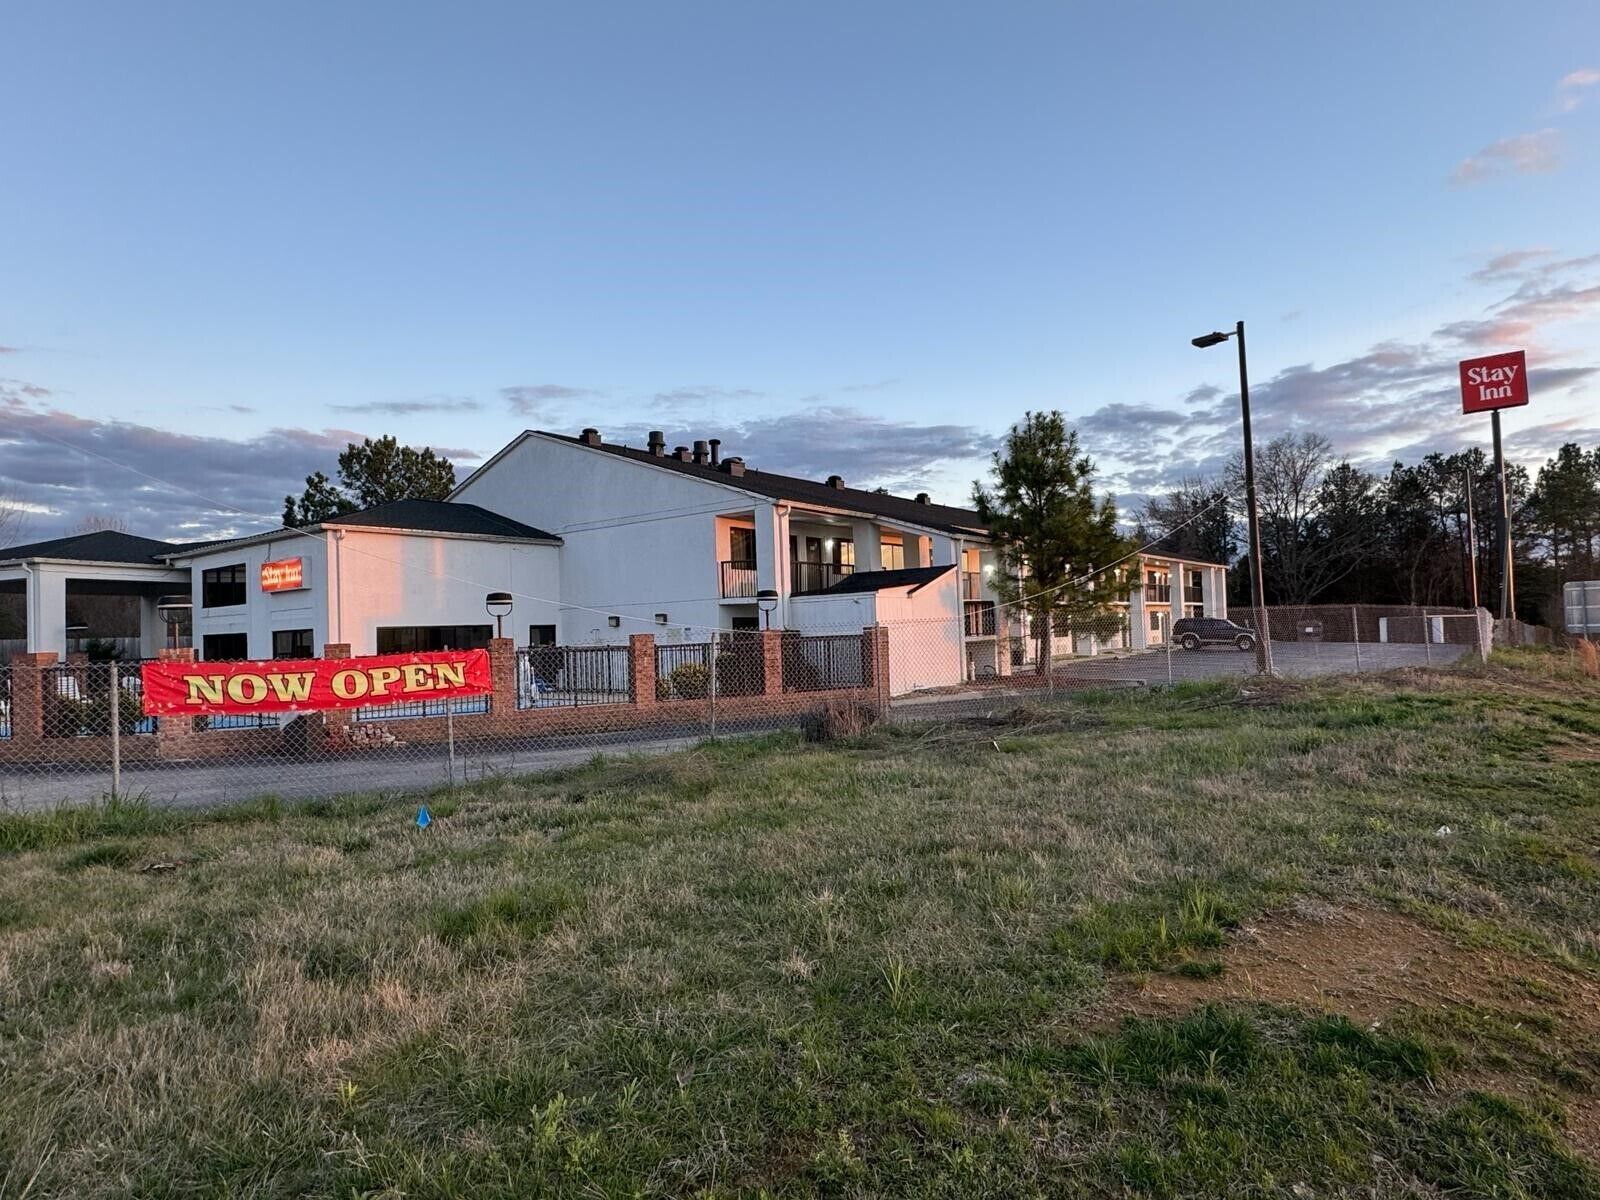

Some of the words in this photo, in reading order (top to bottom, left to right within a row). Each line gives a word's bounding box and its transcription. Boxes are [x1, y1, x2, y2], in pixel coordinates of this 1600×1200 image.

[1467, 365, 1519, 385] Stay
[1479, 385, 1512, 401] Inn
[262, 566, 281, 589] Stay
[183, 672, 315, 705] NOW
[331, 661, 468, 699] OPEN
